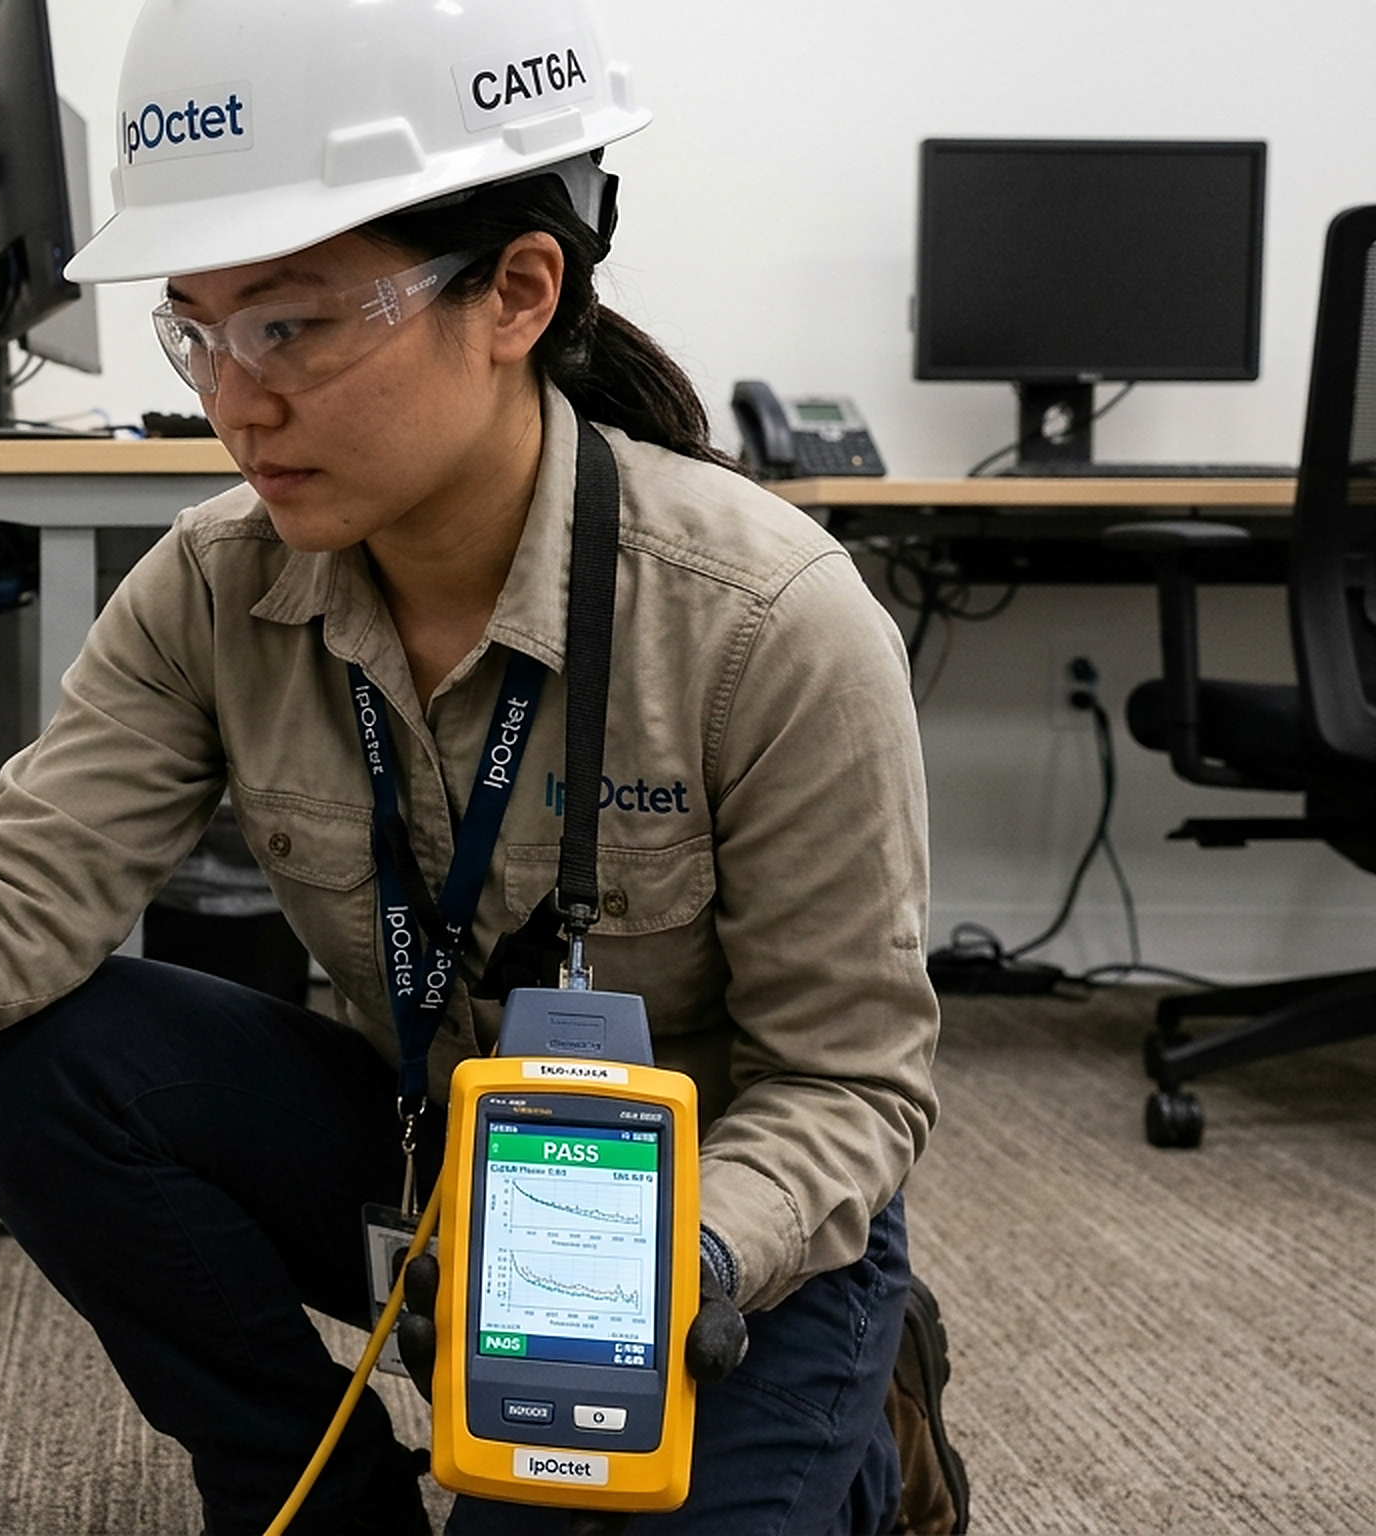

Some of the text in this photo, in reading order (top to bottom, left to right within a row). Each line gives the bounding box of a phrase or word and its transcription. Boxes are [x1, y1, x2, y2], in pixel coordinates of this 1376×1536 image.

[472, 49, 586, 110] CAT6A
[122, 94, 243, 164] IpOctet
[483, 697, 528, 789] IpOctet
[543, 1142, 600, 1163] PASS
[529, 1457, 592, 1477] IpOctet
